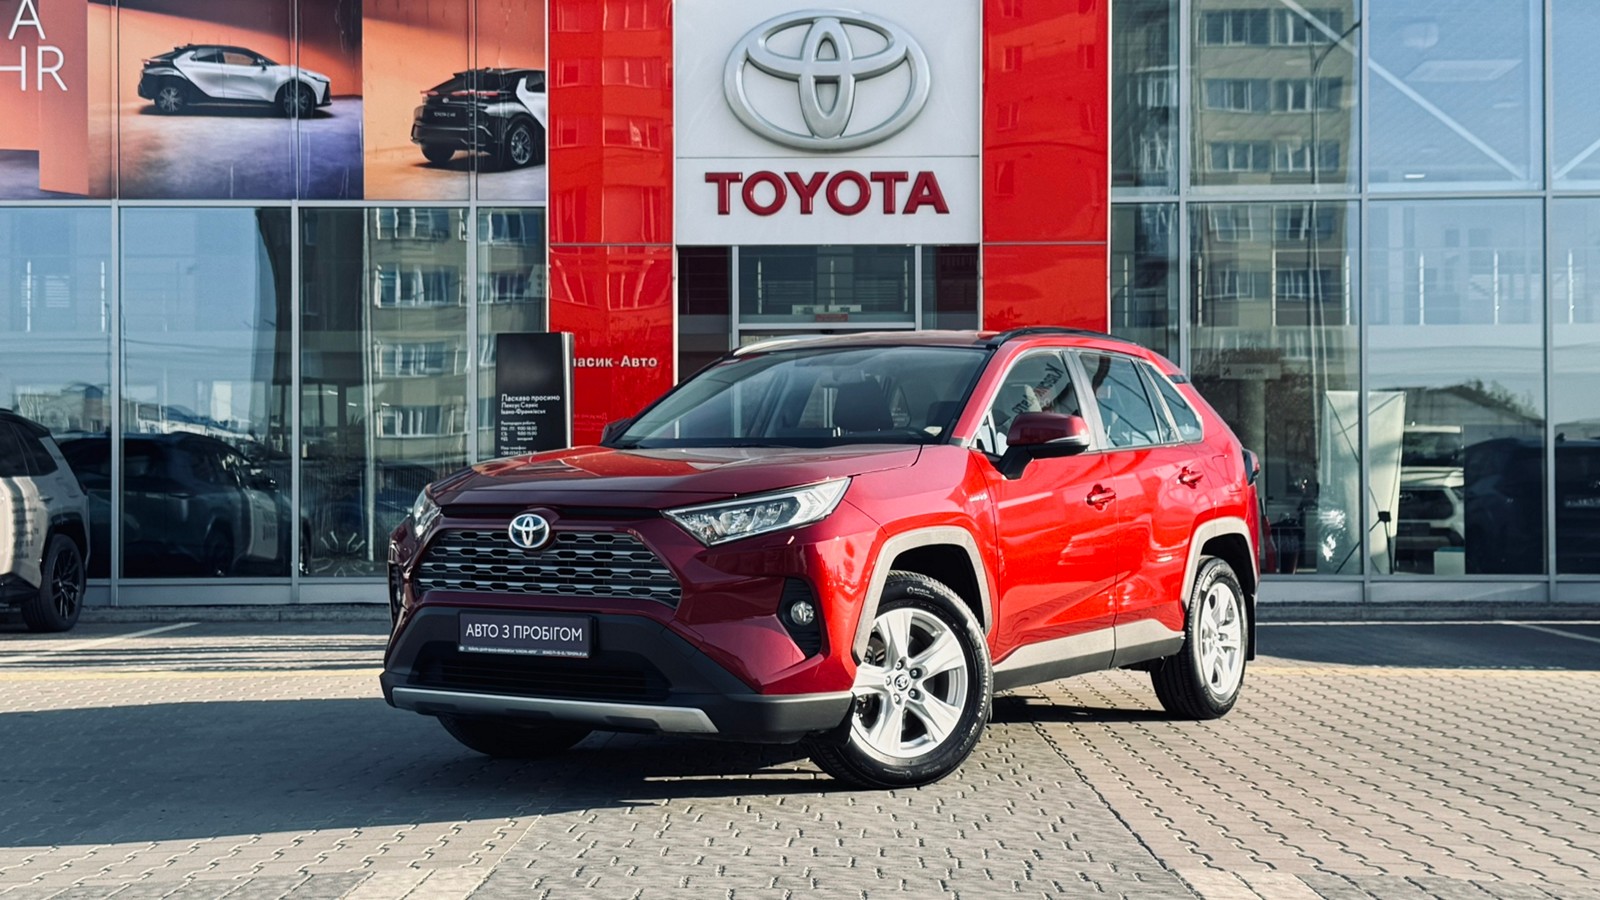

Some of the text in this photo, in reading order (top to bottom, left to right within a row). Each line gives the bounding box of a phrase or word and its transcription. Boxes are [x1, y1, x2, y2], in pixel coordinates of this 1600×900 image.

[8, 0, 46, 40] A
[704, 170, 950, 216] TOYOTA
[465, 623, 583, 642] АВТО З ПРОБІГОМ
